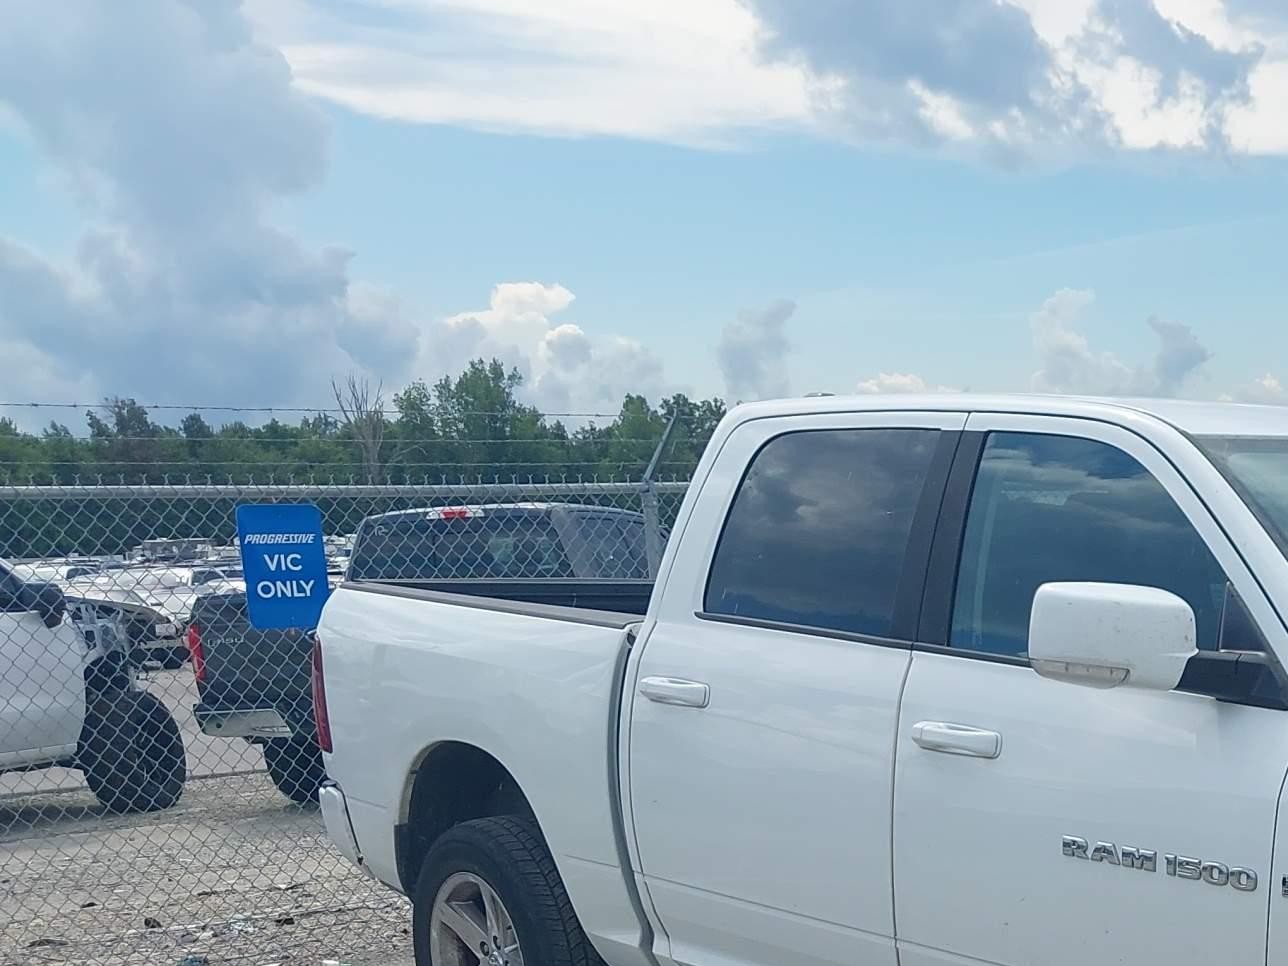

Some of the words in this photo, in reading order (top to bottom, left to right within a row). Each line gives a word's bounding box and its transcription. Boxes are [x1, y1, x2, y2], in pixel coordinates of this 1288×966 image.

[244, 533, 316, 545] PROGRESSIVE
[264, 553, 303, 571] VIC
[257, 580, 315, 598] ONLY
[1062, 834, 1157, 873] RAM
[1164, 853, 1258, 892] 1500
